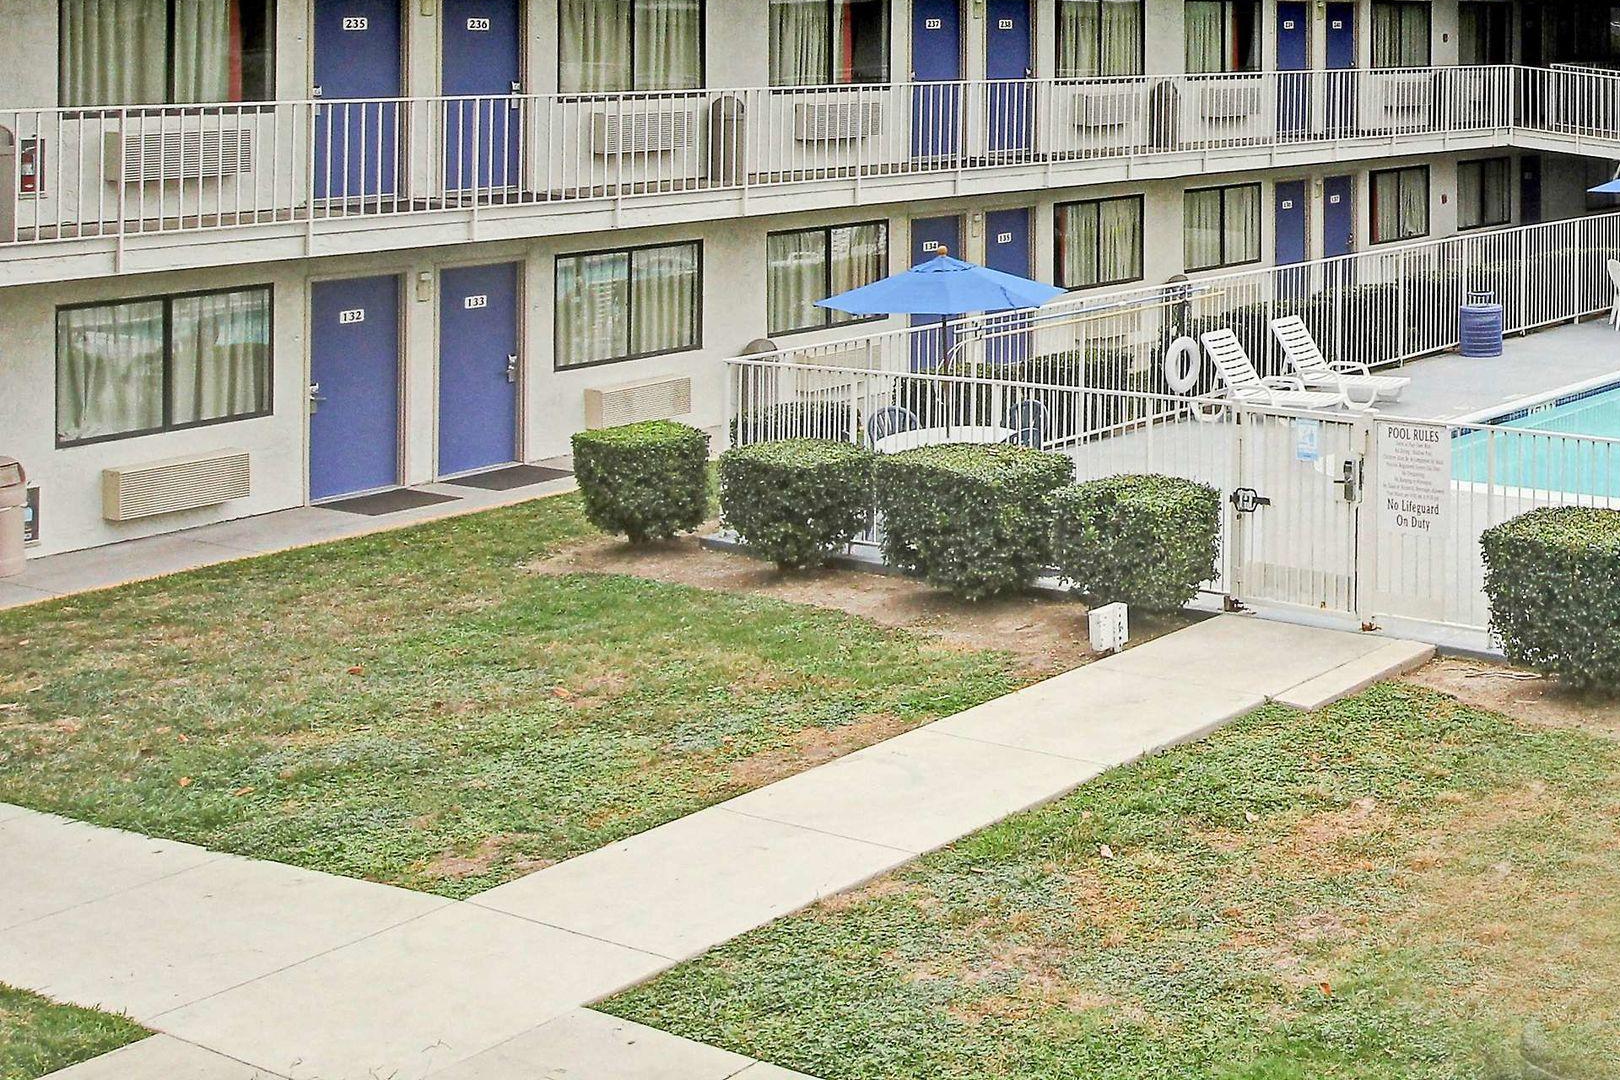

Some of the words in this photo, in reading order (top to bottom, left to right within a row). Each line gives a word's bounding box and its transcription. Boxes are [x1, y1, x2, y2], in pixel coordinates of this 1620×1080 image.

[344, 18, 366, 29] 235
[469, 19, 488, 29] 236
[927, 20, 940, 28] 237
[467, 296, 485, 307] 133
[342, 310, 363, 322] 132
[1388, 427, 1410, 440] POOL
[1413, 429, 1439, 442] RULES
[1387, 498, 1399, 510] No
[1401, 500, 1439, 516] Lifeguard
[1396, 514, 1408, 527] On
[1411, 516, 1430, 531] Duty
